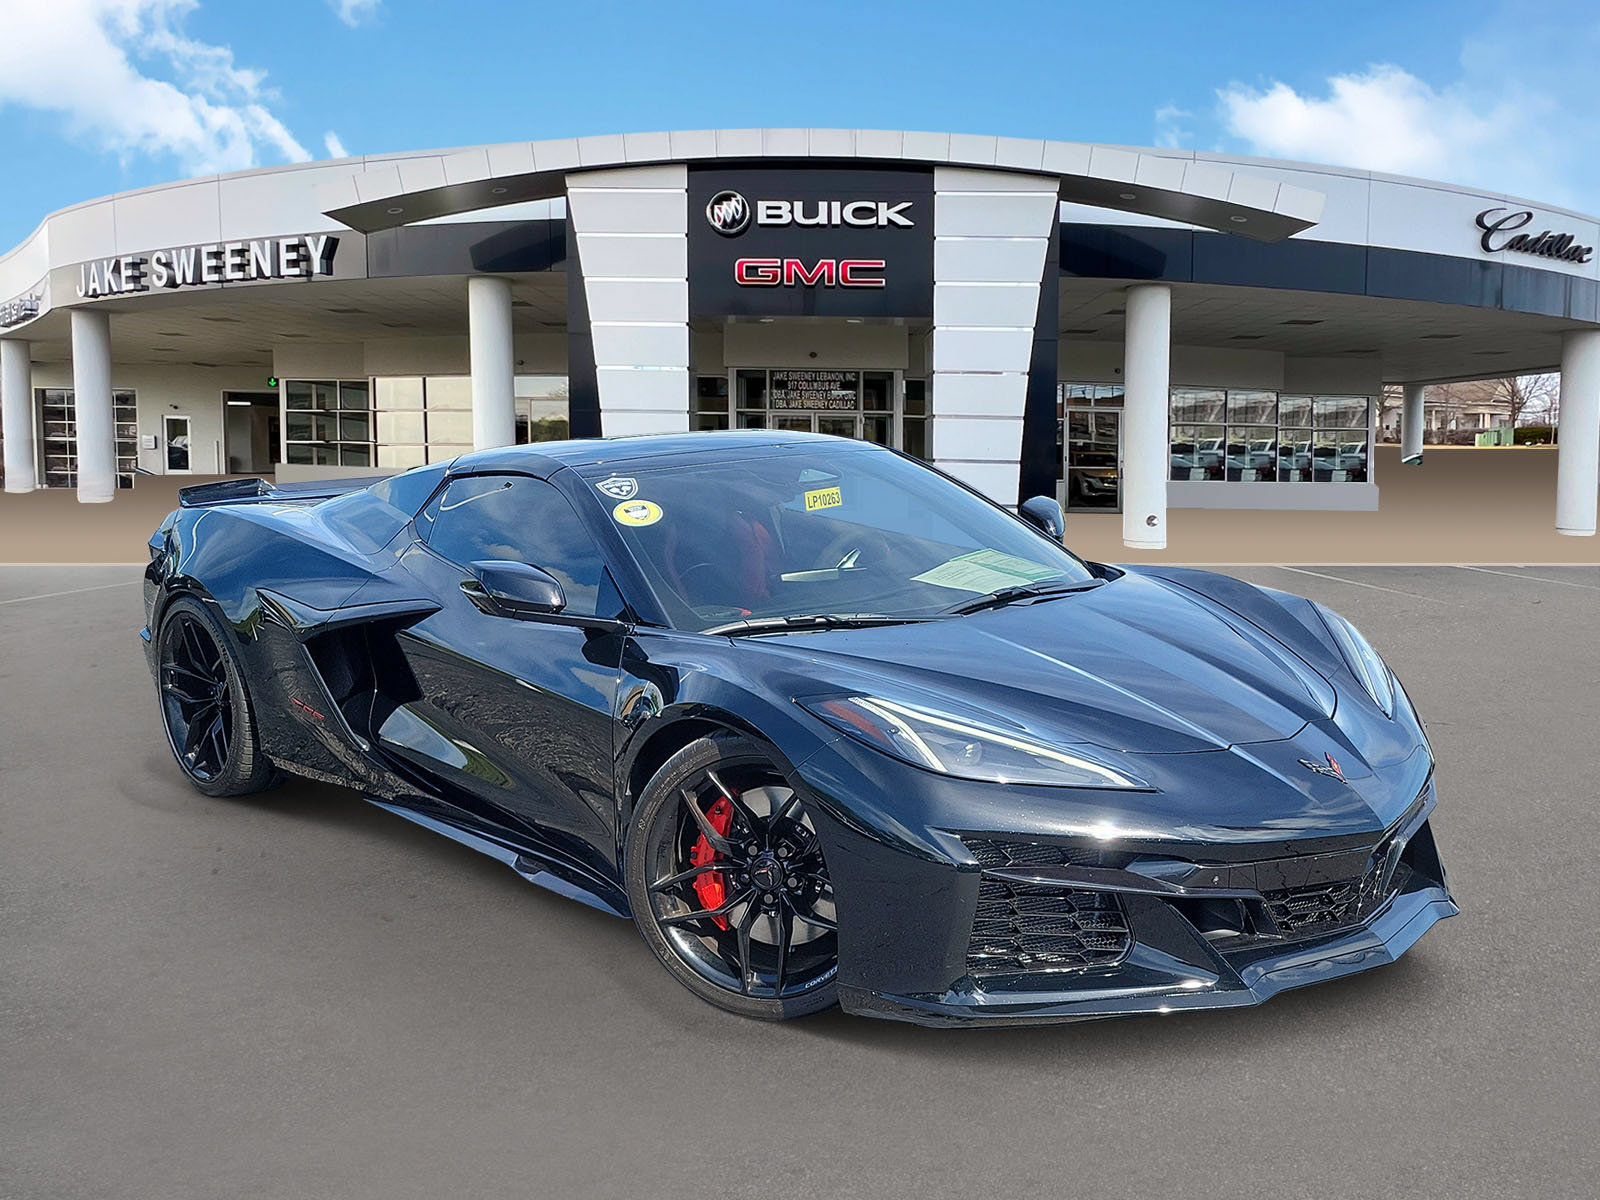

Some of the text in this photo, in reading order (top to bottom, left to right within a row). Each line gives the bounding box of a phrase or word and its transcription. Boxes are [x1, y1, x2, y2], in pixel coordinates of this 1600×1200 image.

[757, 200, 915, 226] BUICK
[1475, 207, 1593, 263] Cadillac
[76, 234, 339, 298] JAKE SWEENEY
[734, 258, 886, 287] GMC
[773, 371, 788, 380] JAKE
[788, 371, 816, 381] SWEENEY
[803, 400, 828, 409] SWEENEY
[828, 400, 855, 409] CADILLAC
[807, 491, 840, 509] LP10263
